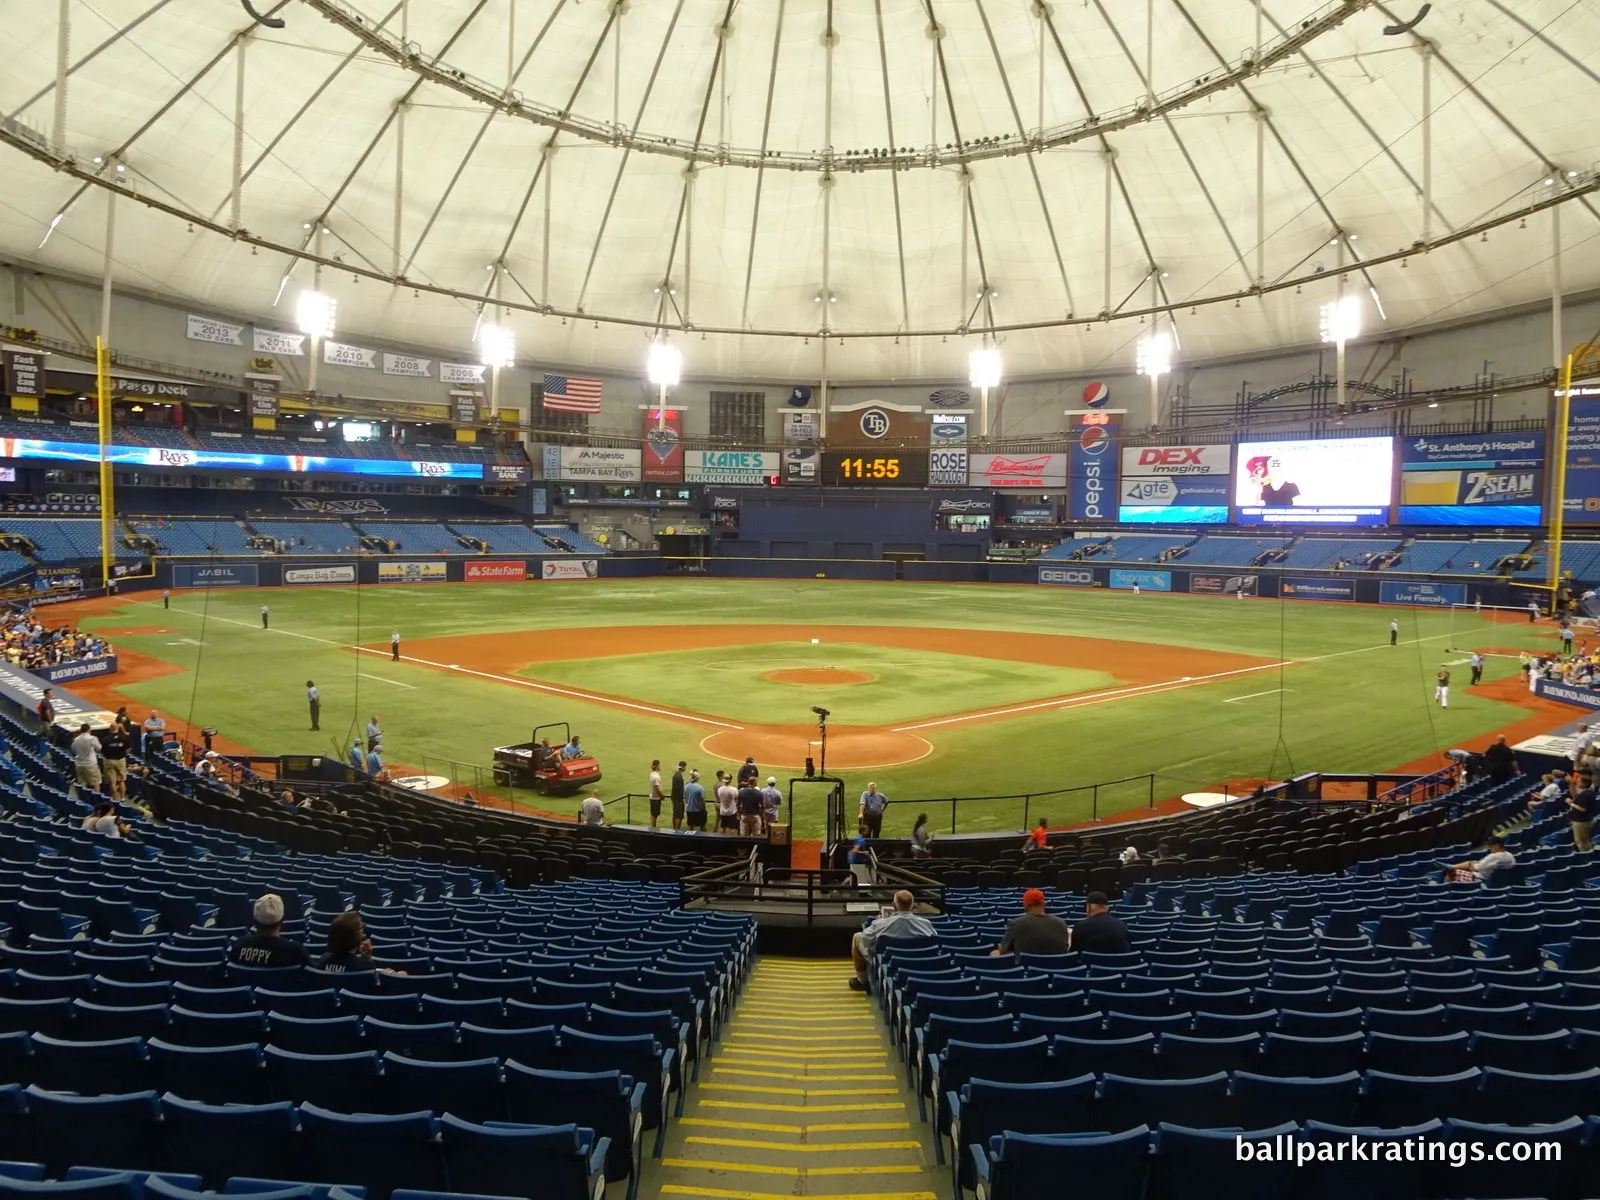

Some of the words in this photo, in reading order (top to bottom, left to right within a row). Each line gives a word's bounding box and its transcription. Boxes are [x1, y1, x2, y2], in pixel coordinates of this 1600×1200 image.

[202, 325, 230, 338] 2013
[194, 332, 212, 340] WILD
[214, 336, 235, 344] CARD
[266, 338, 291, 348] 2011
[14, 354, 35, 364] Fast
[336, 350, 364, 361] 2010
[328, 356, 370, 367] CHAMPIONS
[394, 361, 420, 370] 2008
[12, 364, 38, 372] news
[386, 367, 426, 376] CHAMPIONS
[16, 372, 36, 380] you
[158, 386, 188, 396] Deck
[865, 414, 885, 434] TB
[1443, 442, 1490, 452] Anthony's
[1492, 440, 1535, 451] Hospital
[546, 448, 557, 456] 42
[592, 451, 625, 460] Majestic
[1137, 448, 1206, 466] DEX
[702, 452, 763, 468] KANE'S
[931, 454, 966, 470] ROSE
[568, 468, 596, 476] TAMPA
[598, 468, 614, 477] BAY
[840, 458, 900, 478] 11:55
[992, 462, 1044, 472] Budweiser
[1152, 465, 1211, 474] imaging
[930, 470, 966, 484] RADIOLOGY
[1084, 460, 1104, 518] pepsi
[288, 572, 314, 580] Tampa
[314, 572, 330, 580] Bay
[1040, 570, 1092, 582] GEICO
[1414, 594, 1448, 604] Fiercely.
[51, 666, 86, 680] RAYMOND
[86, 662, 108, 673] JAMES
[1543, 686, 1578, 700] RAYMOND
[239, 947, 272, 964] POPPY
